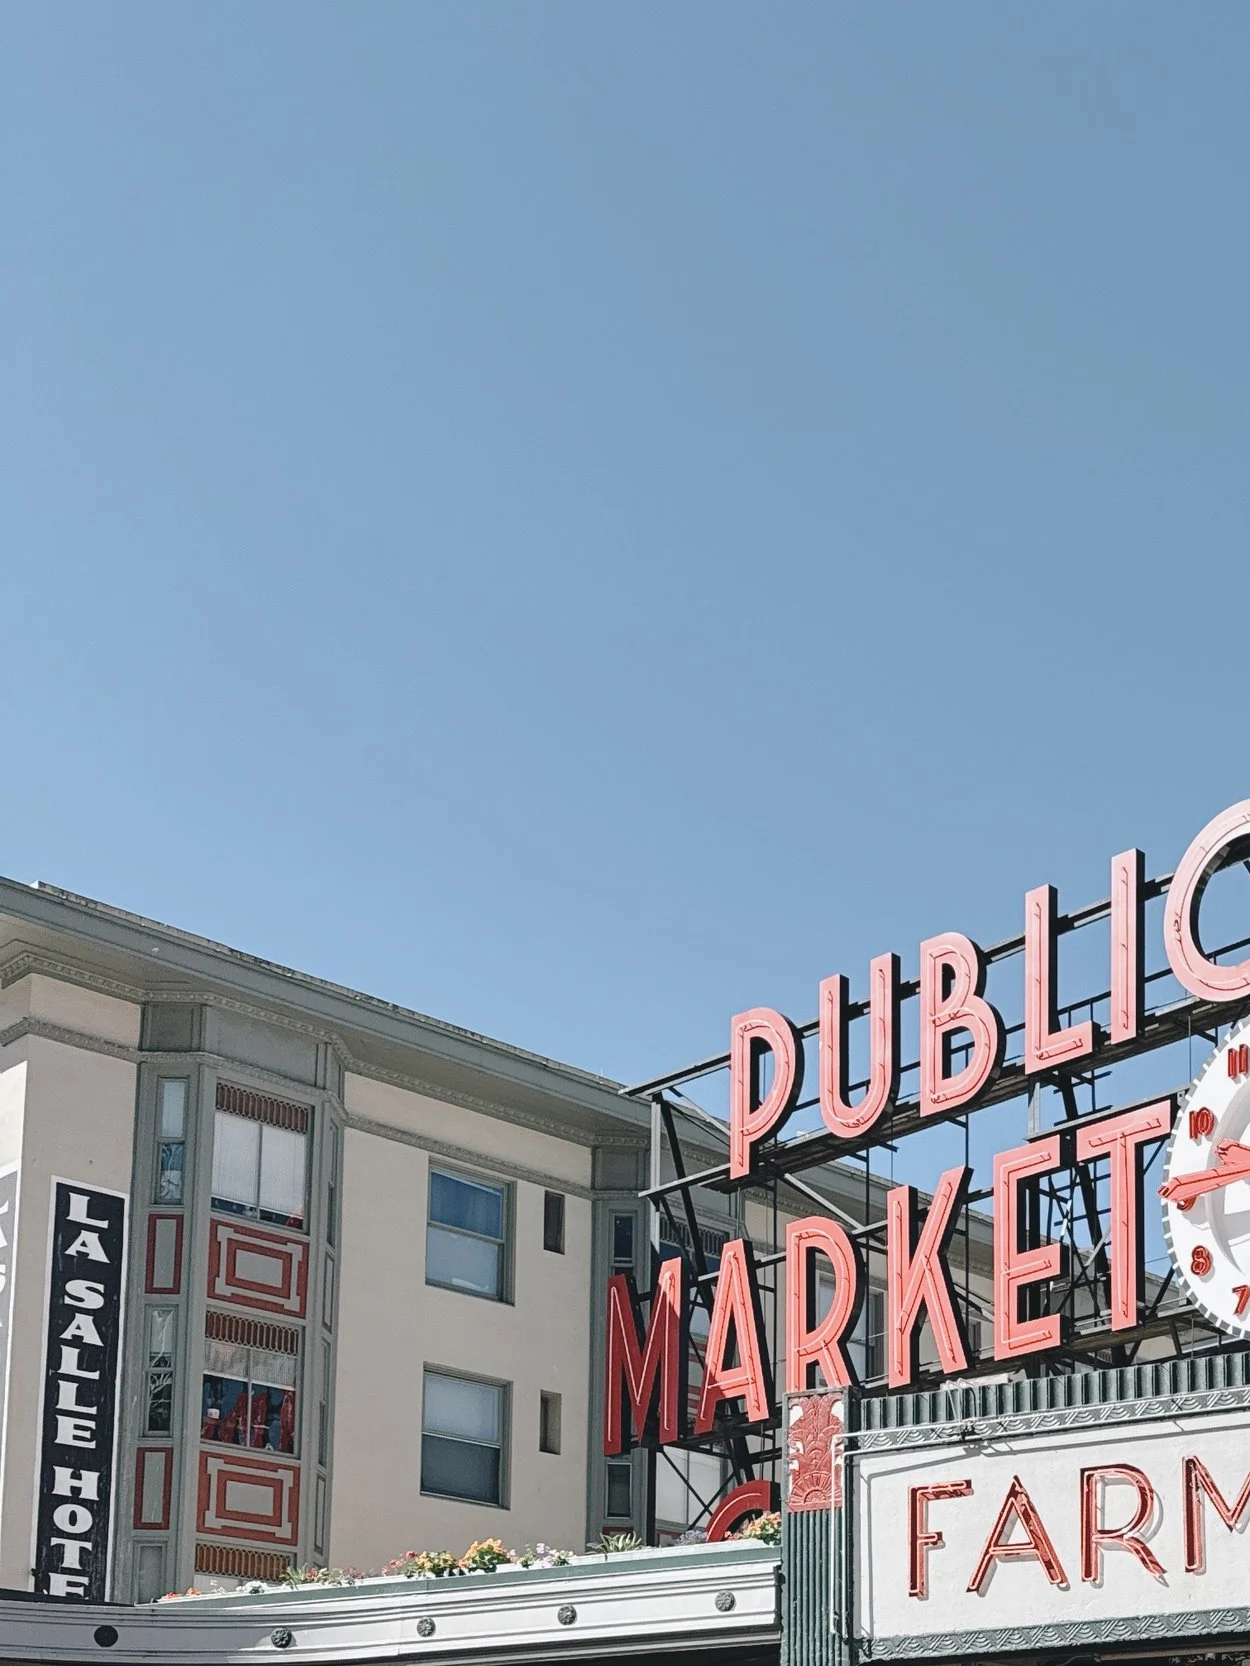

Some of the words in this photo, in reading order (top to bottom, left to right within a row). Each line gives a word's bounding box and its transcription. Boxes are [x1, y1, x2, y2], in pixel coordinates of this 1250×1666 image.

[1227, 1044, 1249, 1078] 11
[1189, 1107, 1215, 1140] 10
[64, 1192, 111, 1265] LA
[1190, 1245, 1212, 1277] 8
[604, 1102, 1171, 1456] MARKET
[1232, 1284, 1250, 1317] 7
[54, 1279, 105, 1450] SALLE
